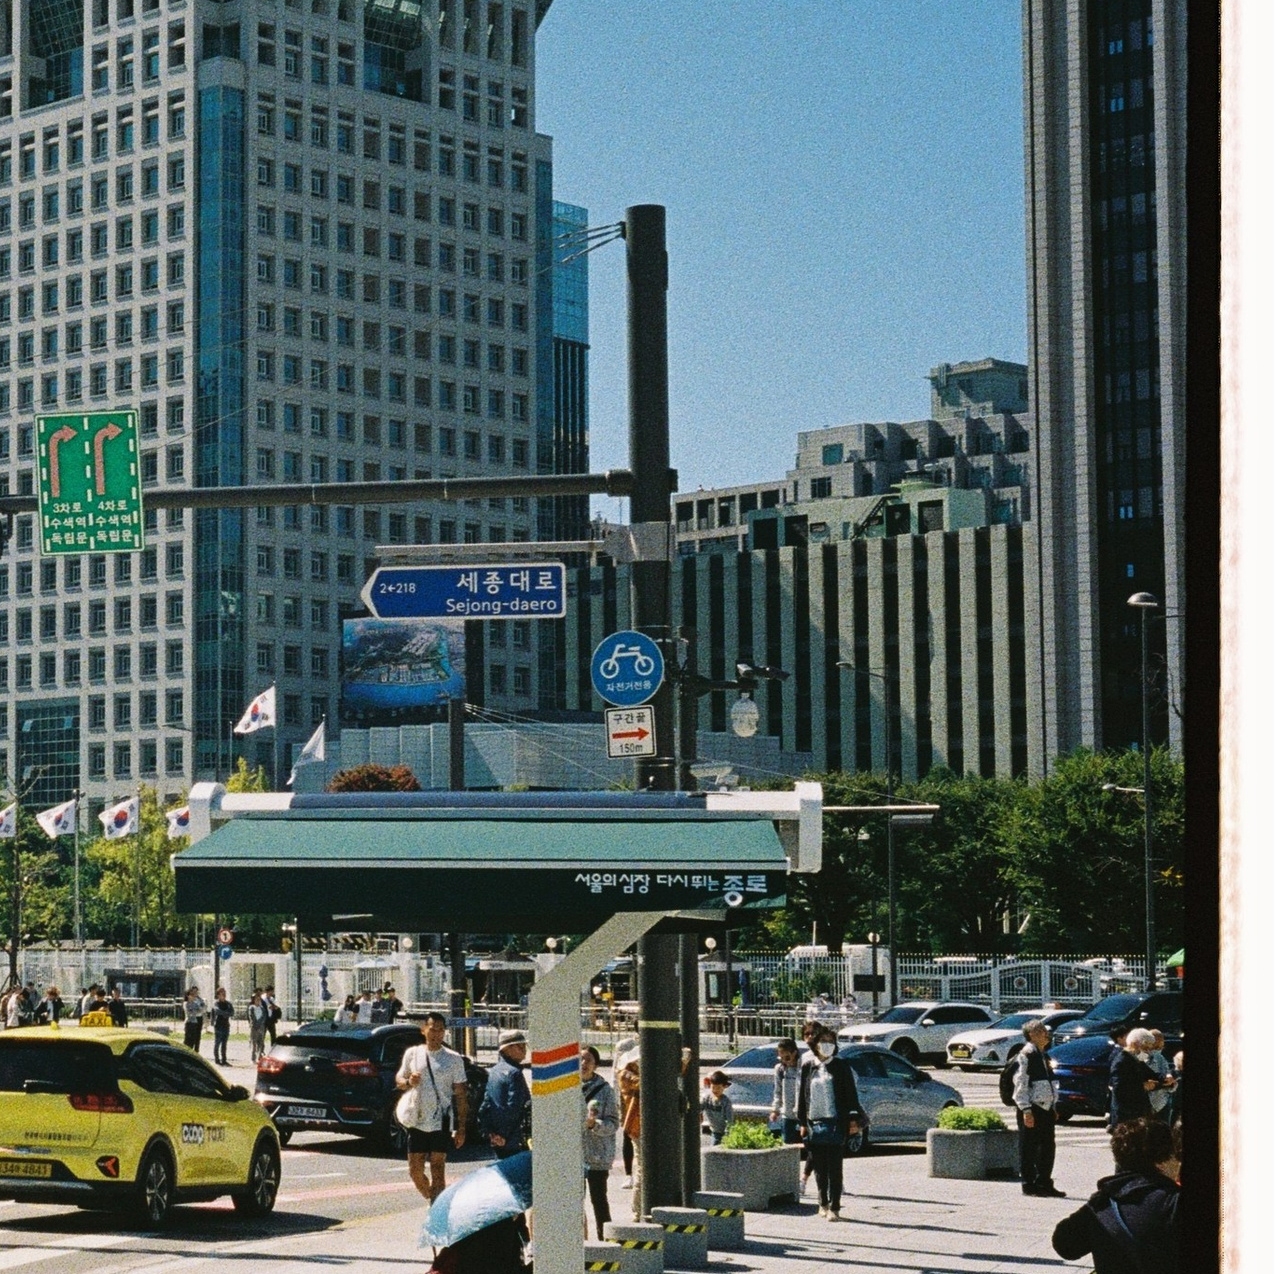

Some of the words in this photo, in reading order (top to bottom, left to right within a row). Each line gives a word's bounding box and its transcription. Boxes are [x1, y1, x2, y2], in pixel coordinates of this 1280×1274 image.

[53, 502, 83, 513] 3차로
[98, 499, 128, 511] 4차로
[51, 516, 87, 529] 수색역
[95, 514, 132, 527] 수색역
[51, 531, 87, 545] 독립문
[96, 529, 133, 542] 독립문
[457, 570, 557, 595] 세종대로
[446, 598, 557, 615] Sejong-daero
[619, 743, 644, 754] 150m
[656, 874, 688, 888] 다시
[691, 875, 719, 891] 뛰는
[722, 875, 768, 907] 종로
[83, 1017, 108, 1026] TAXI
